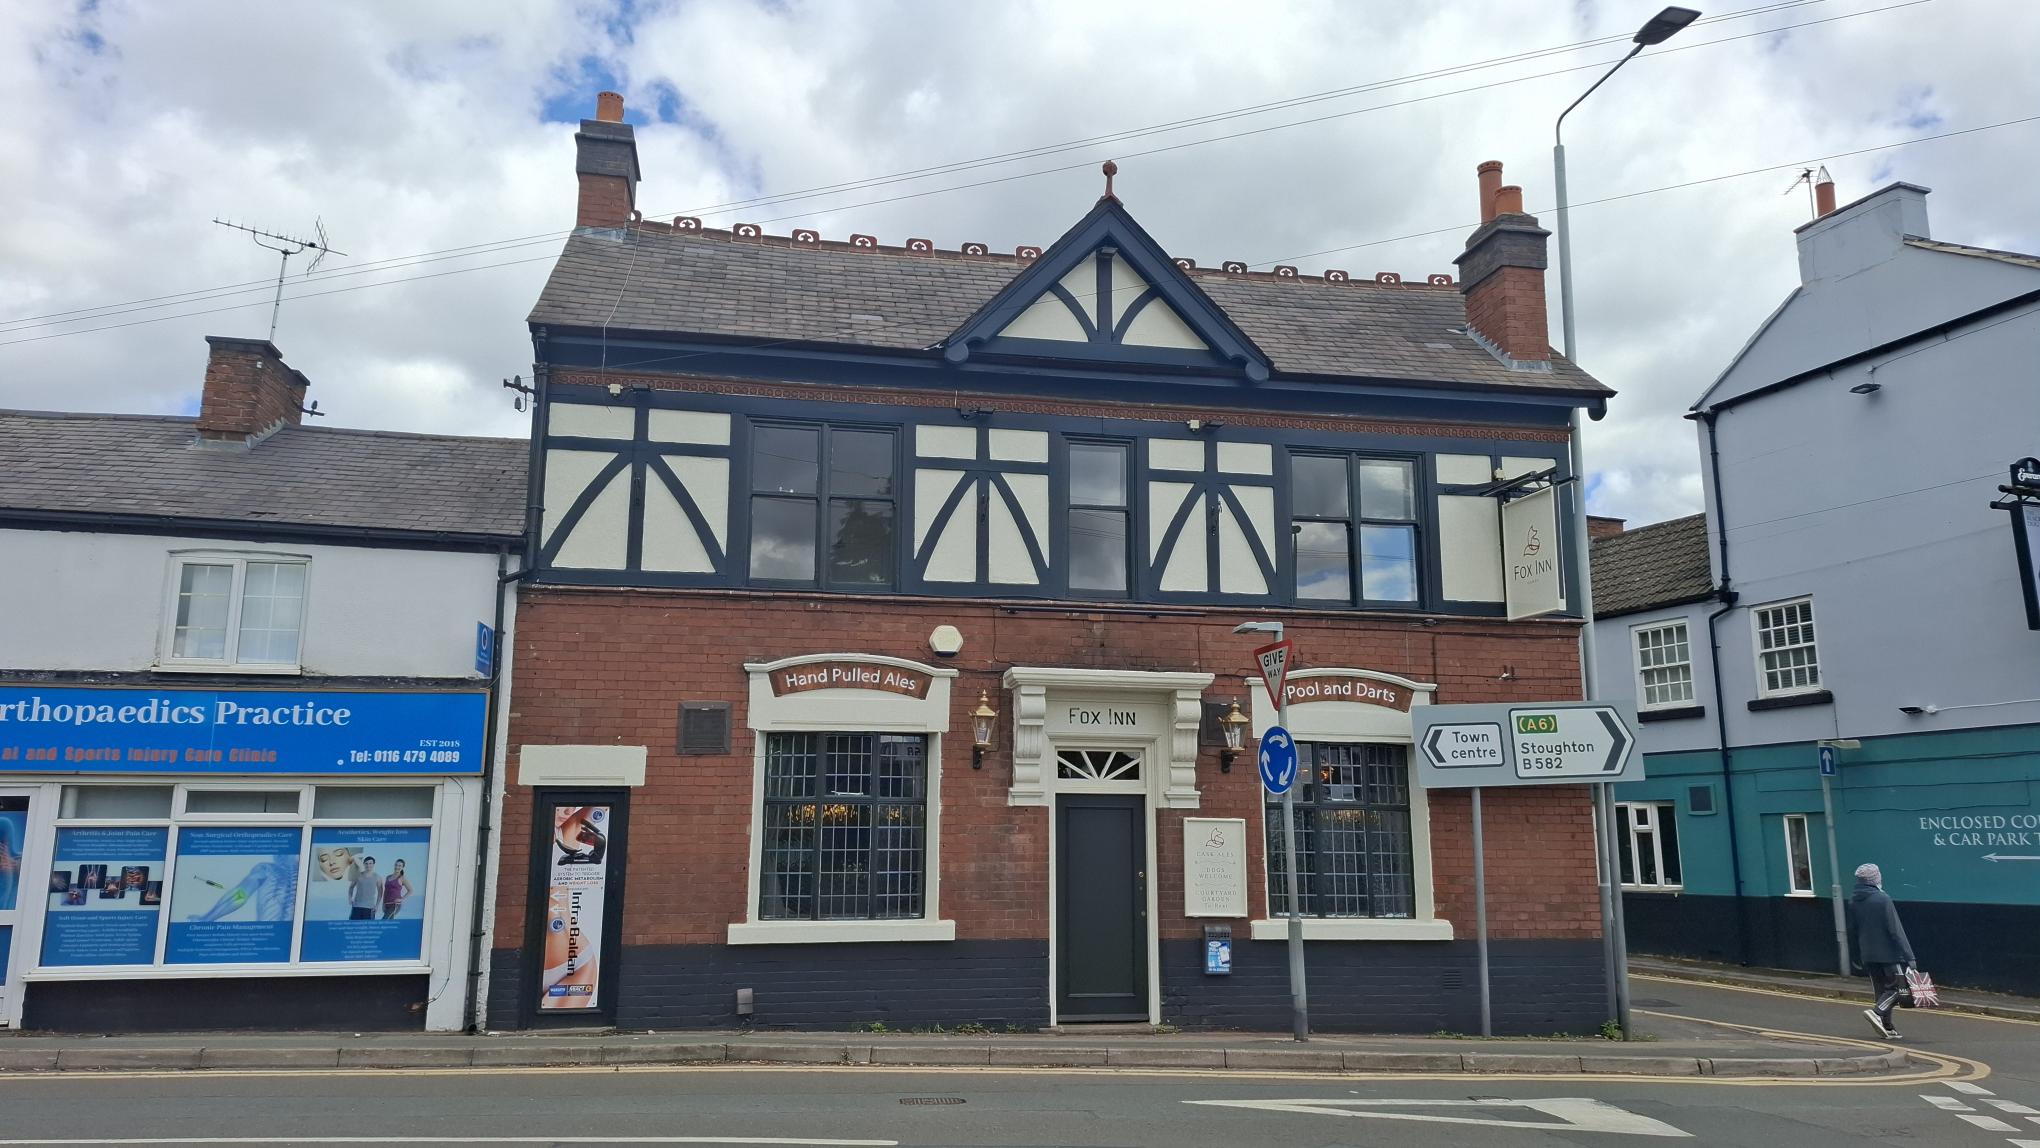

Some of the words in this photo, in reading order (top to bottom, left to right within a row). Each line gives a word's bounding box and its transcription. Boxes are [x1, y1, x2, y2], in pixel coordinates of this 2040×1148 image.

[1514, 563, 1532, 581] FOX
[1535, 558, 1552, 575] INN
[1263, 650, 1284, 667] GIVE
[785, 669, 828, 687] Hand
[832, 668, 881, 683] Pulled
[884, 672, 916, 690] Ales
[1267, 667, 1281, 679] WAY
[1286, 682, 1320, 699] Pool
[1324, 682, 1351, 696] and
[1356, 682, 1396, 703] Darts
[214, 701, 351, 726] Practice
[1069, 707, 1101, 725] FOX
[1108, 708, 1136, 726] INN
[419, 739, 438, 747] EST
[1452, 731, 1489, 744] Town
[25, 746, 58, 761] and
[65, 746, 121, 763] Sports
[127, 747, 178, 764] Injury
[185, 747, 222, 762] Care
[229, 748, 277, 763] Clinic
[1451, 748, 1497, 759] centre
[1520, 741, 1595, 756] Stoughton
[350, 750, 372, 763] Tel:
[374, 750, 400, 763] 0116
[403, 750, 426, 763] 479
[430, 750, 460, 763] 4089
[1919, 815, 2005, 830] ENCLOSED
[2010, 815, 2040, 829] CO
[1933, 833, 1946, 846] &
[1949, 833, 1984, 846] CAR
[1986, 832, 2032, 846] PARK
